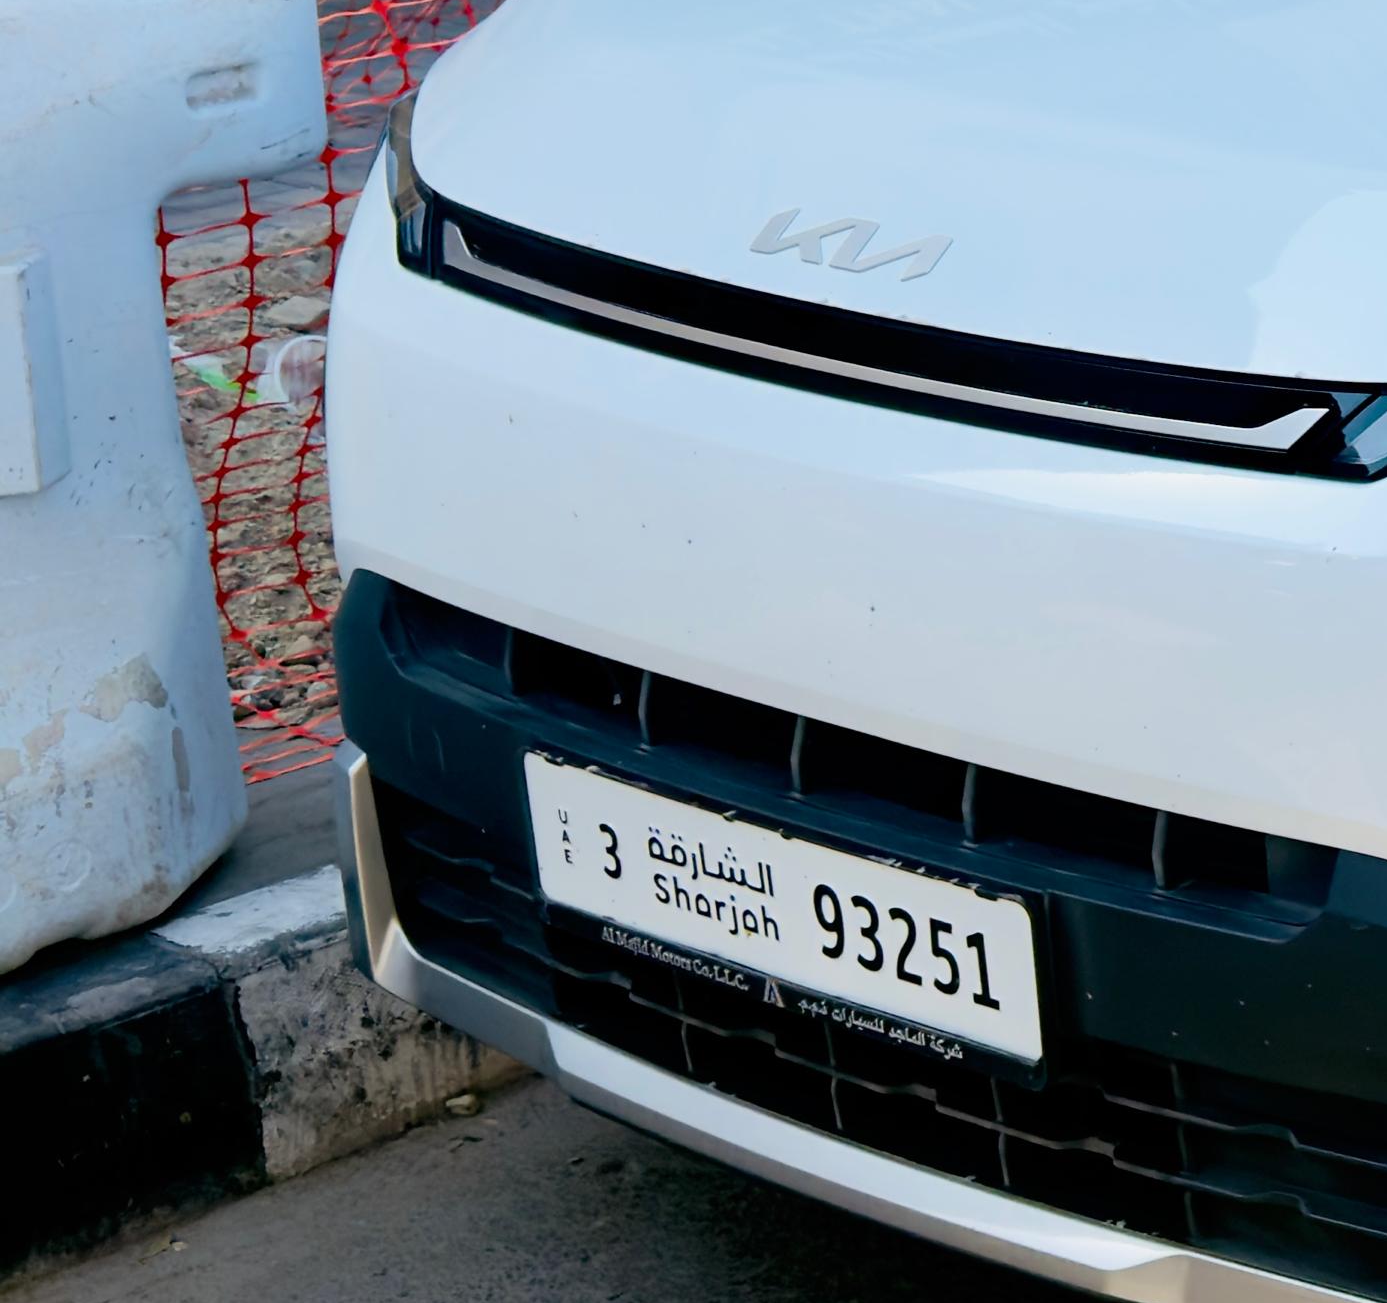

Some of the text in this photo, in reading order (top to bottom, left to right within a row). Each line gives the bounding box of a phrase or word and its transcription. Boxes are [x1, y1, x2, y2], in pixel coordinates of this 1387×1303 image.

[598, 823, 622, 880] 3
[648, 826, 774, 898] الشارقة
[654, 873, 780, 941] Sharjah
[601, 926, 615, 945] Al
[616, 930, 650, 956] Majid
[651, 942, 692, 971] Motors
[812, 883, 1001, 1011] 93251
[929, 1034, 964, 1061] شركة
